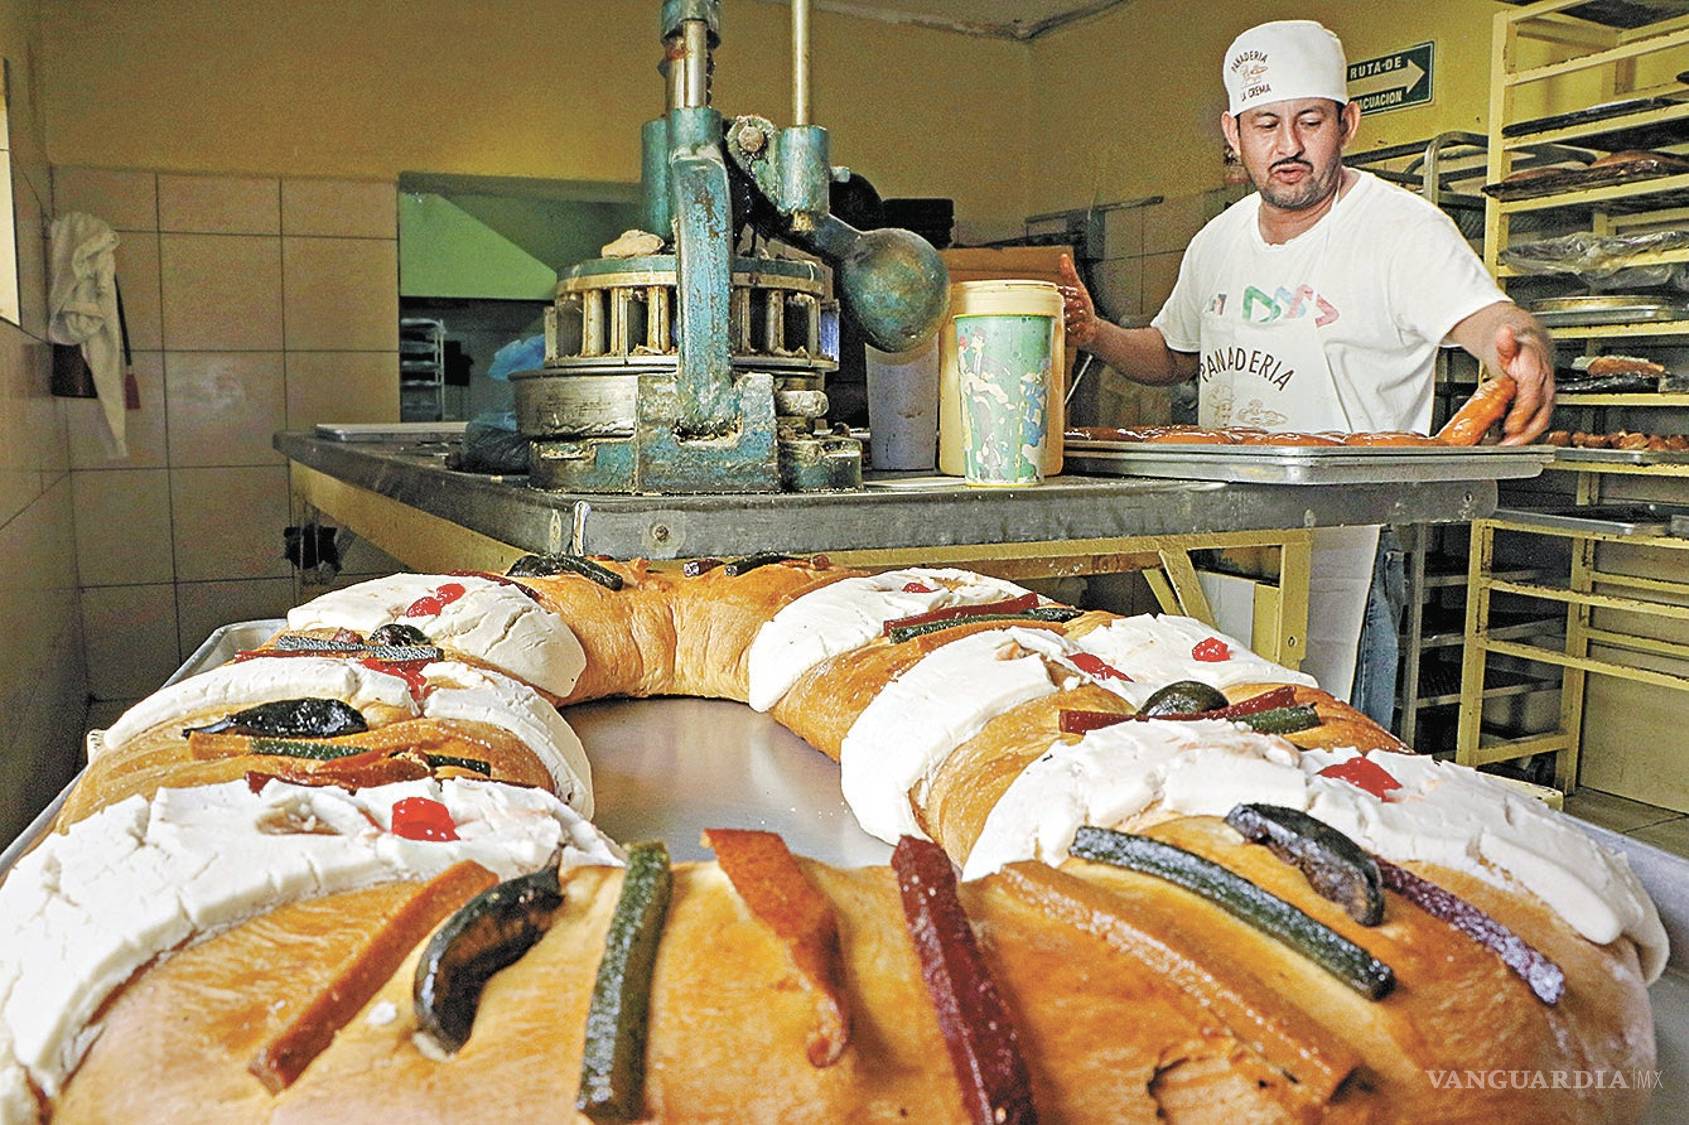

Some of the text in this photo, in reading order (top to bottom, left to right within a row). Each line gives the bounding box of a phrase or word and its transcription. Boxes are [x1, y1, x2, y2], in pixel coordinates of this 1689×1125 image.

[1231, 50, 1268, 73] PANADERIA
[1350, 56, 1402, 80] RUTA DE
[1248, 83, 1271, 98] CREMA
[1200, 346, 1295, 391] PANADERIA
